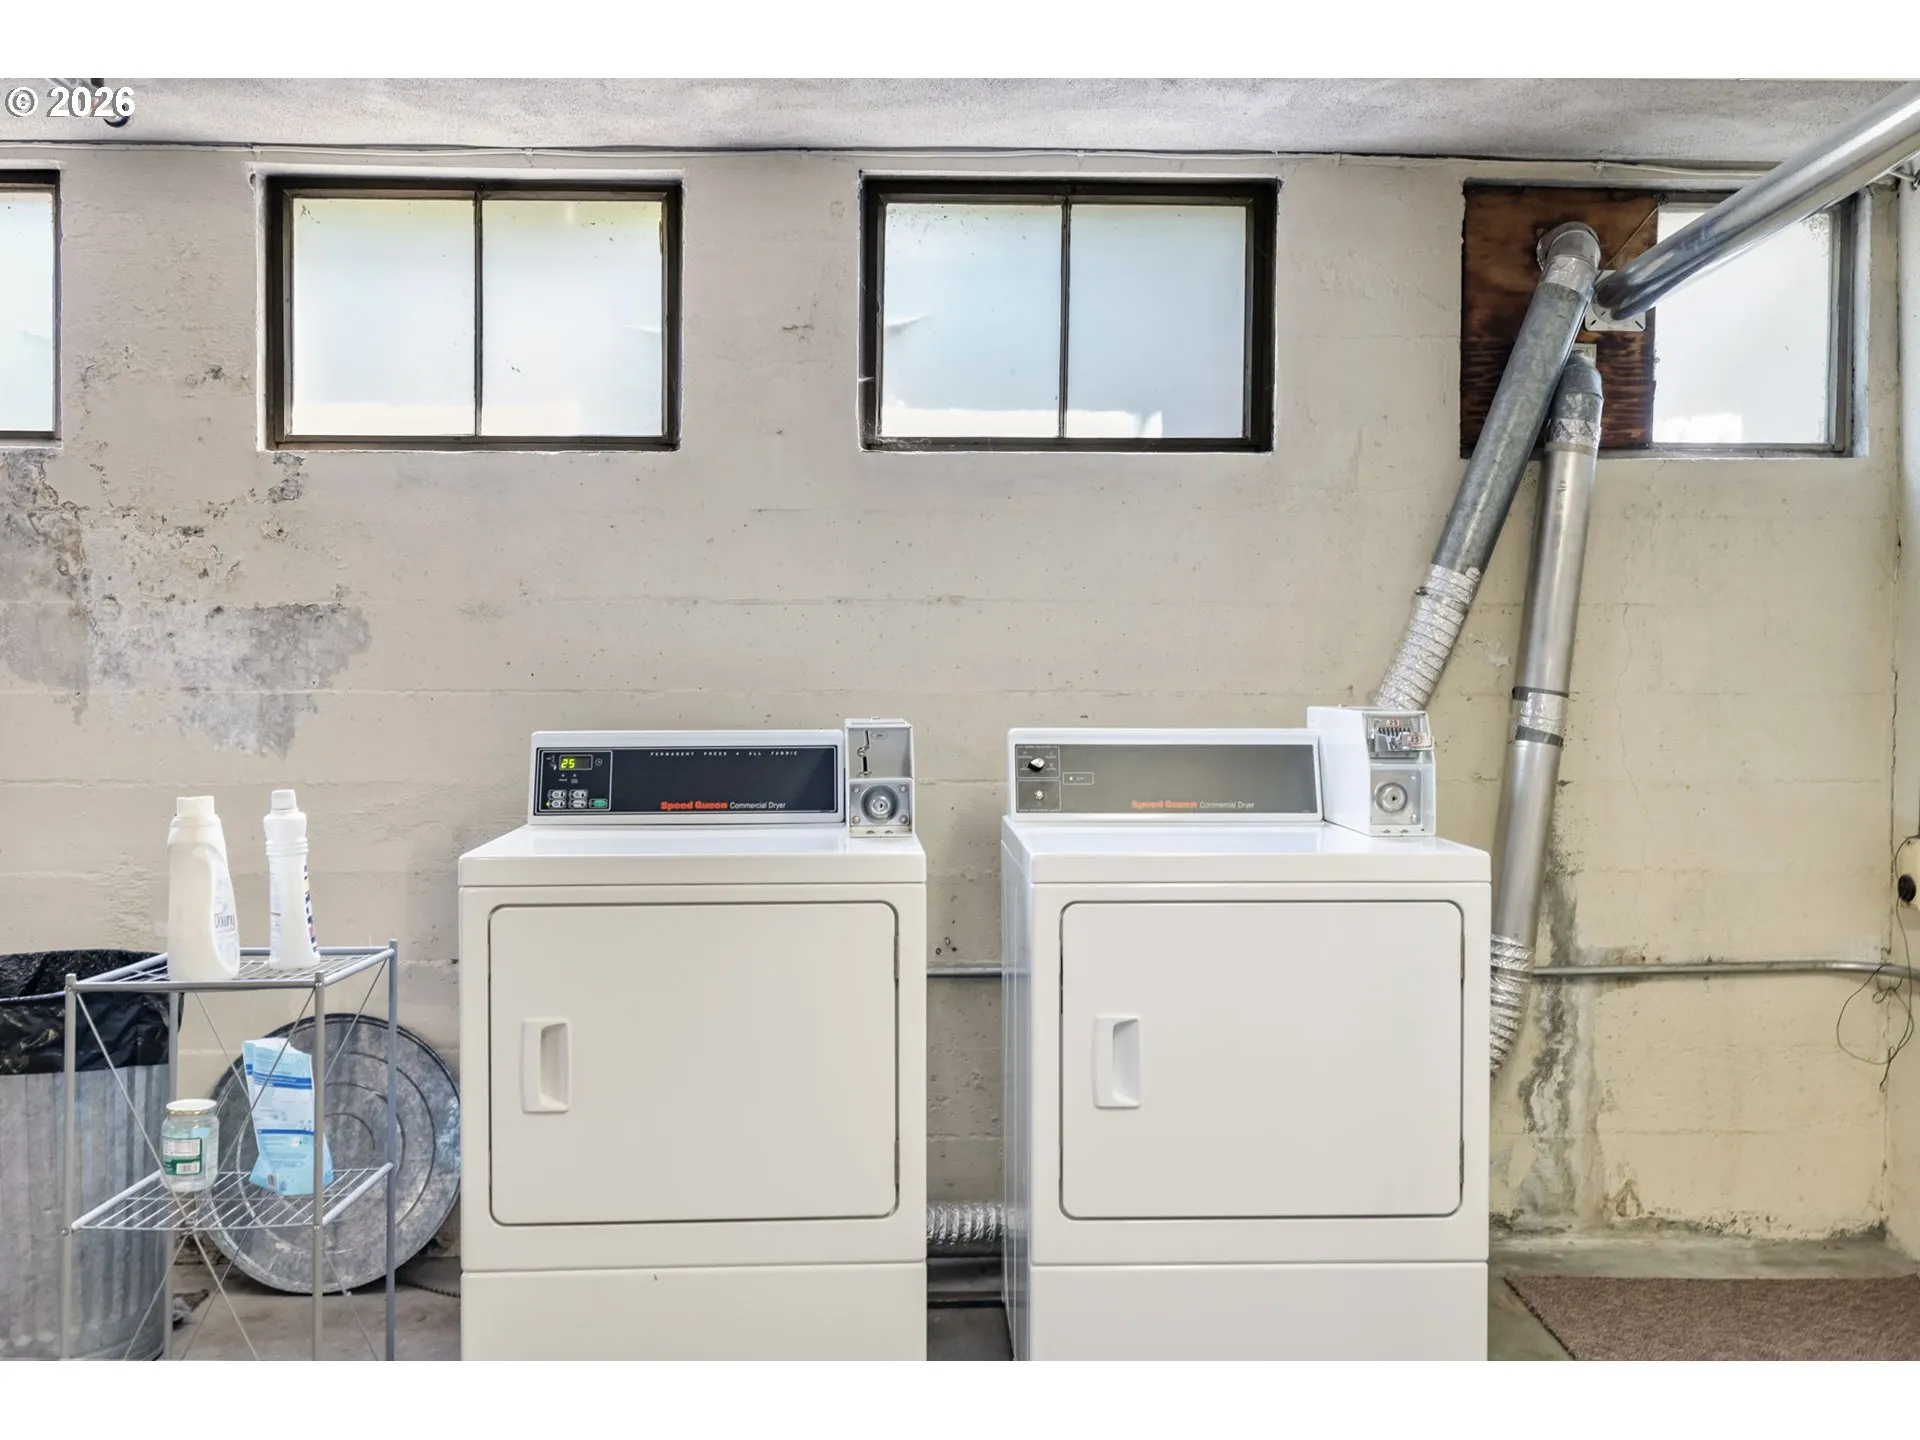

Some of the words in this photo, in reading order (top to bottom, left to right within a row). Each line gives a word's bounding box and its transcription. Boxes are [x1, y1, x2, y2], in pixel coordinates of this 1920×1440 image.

[561, 758, 576, 769] 25
[660, 801, 693, 810] Speed
[695, 801, 728, 810] Queen
[729, 801, 767, 809] Commercial
[768, 801, 786, 810] Dryer
[1199, 800, 1236, 809] Commercial
[1237, 800, 1255, 810] Dryer
